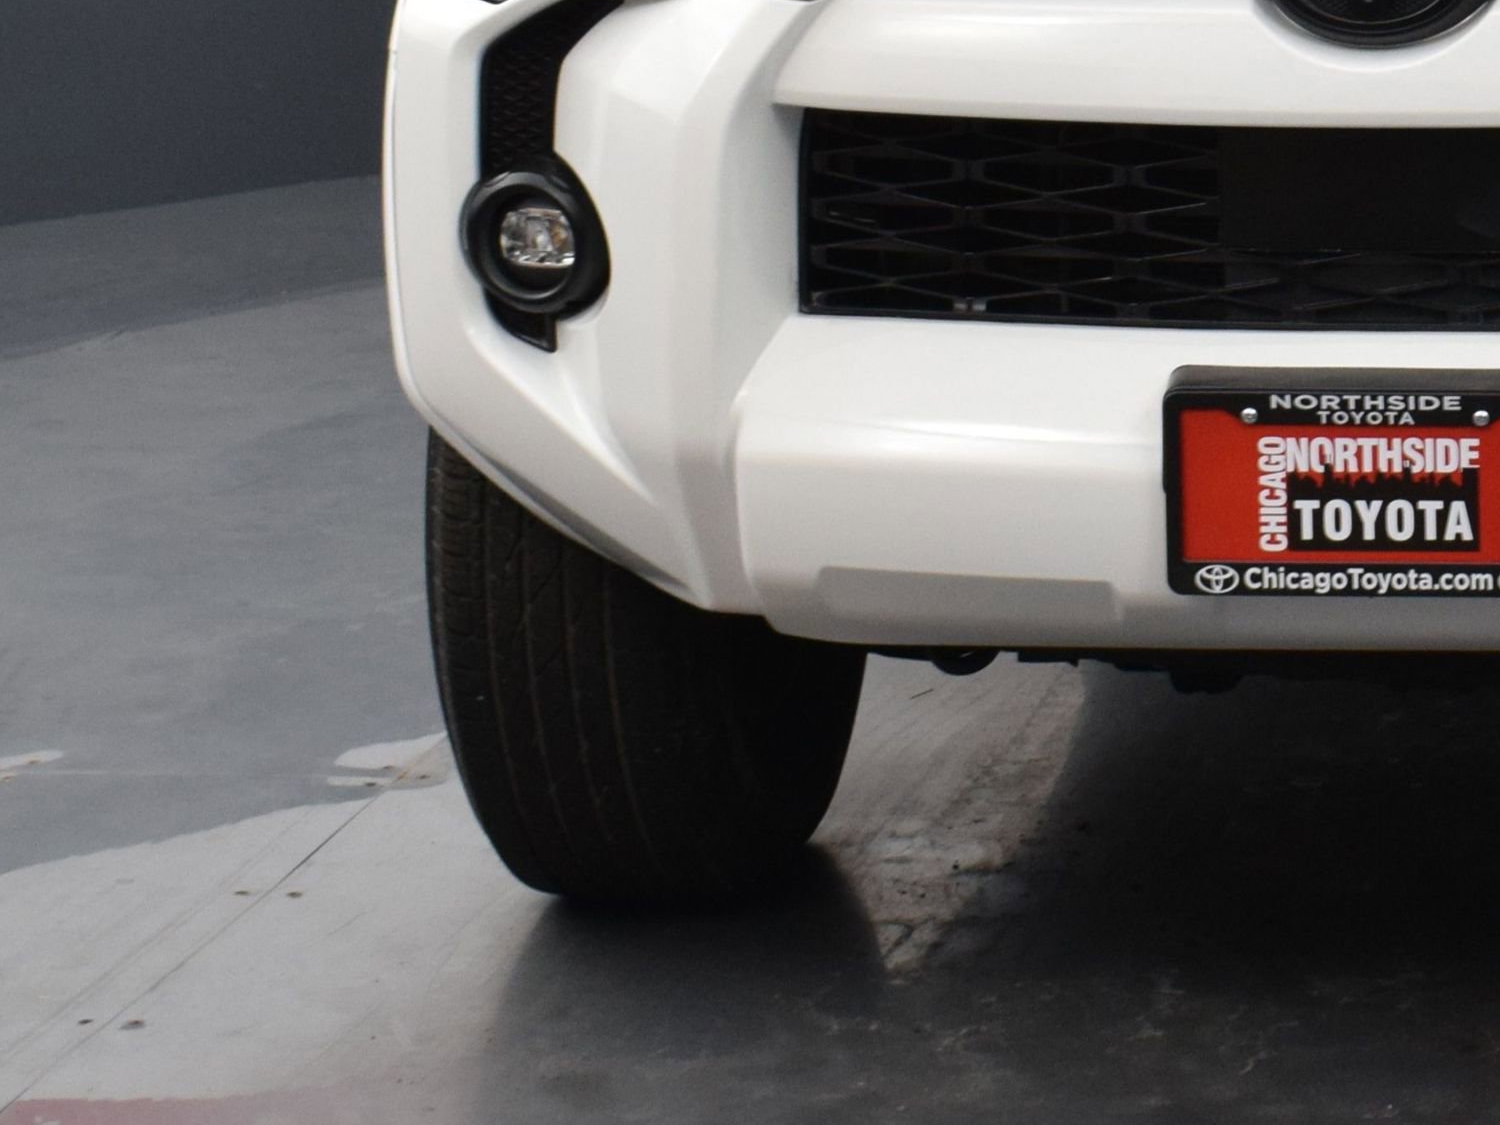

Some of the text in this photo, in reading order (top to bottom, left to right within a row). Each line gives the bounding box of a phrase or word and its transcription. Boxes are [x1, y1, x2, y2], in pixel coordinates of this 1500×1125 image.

[1269, 394, 1462, 411] NORTHSIDE
[1317, 411, 1415, 425] TOYOTA
[1287, 437, 1480, 473] NORTHSIDE
[1258, 436, 1288, 552] CHICAGO
[1294, 499, 1474, 541] TOYOTA
[1244, 567, 1494, 594] ChicagoToyota.com
